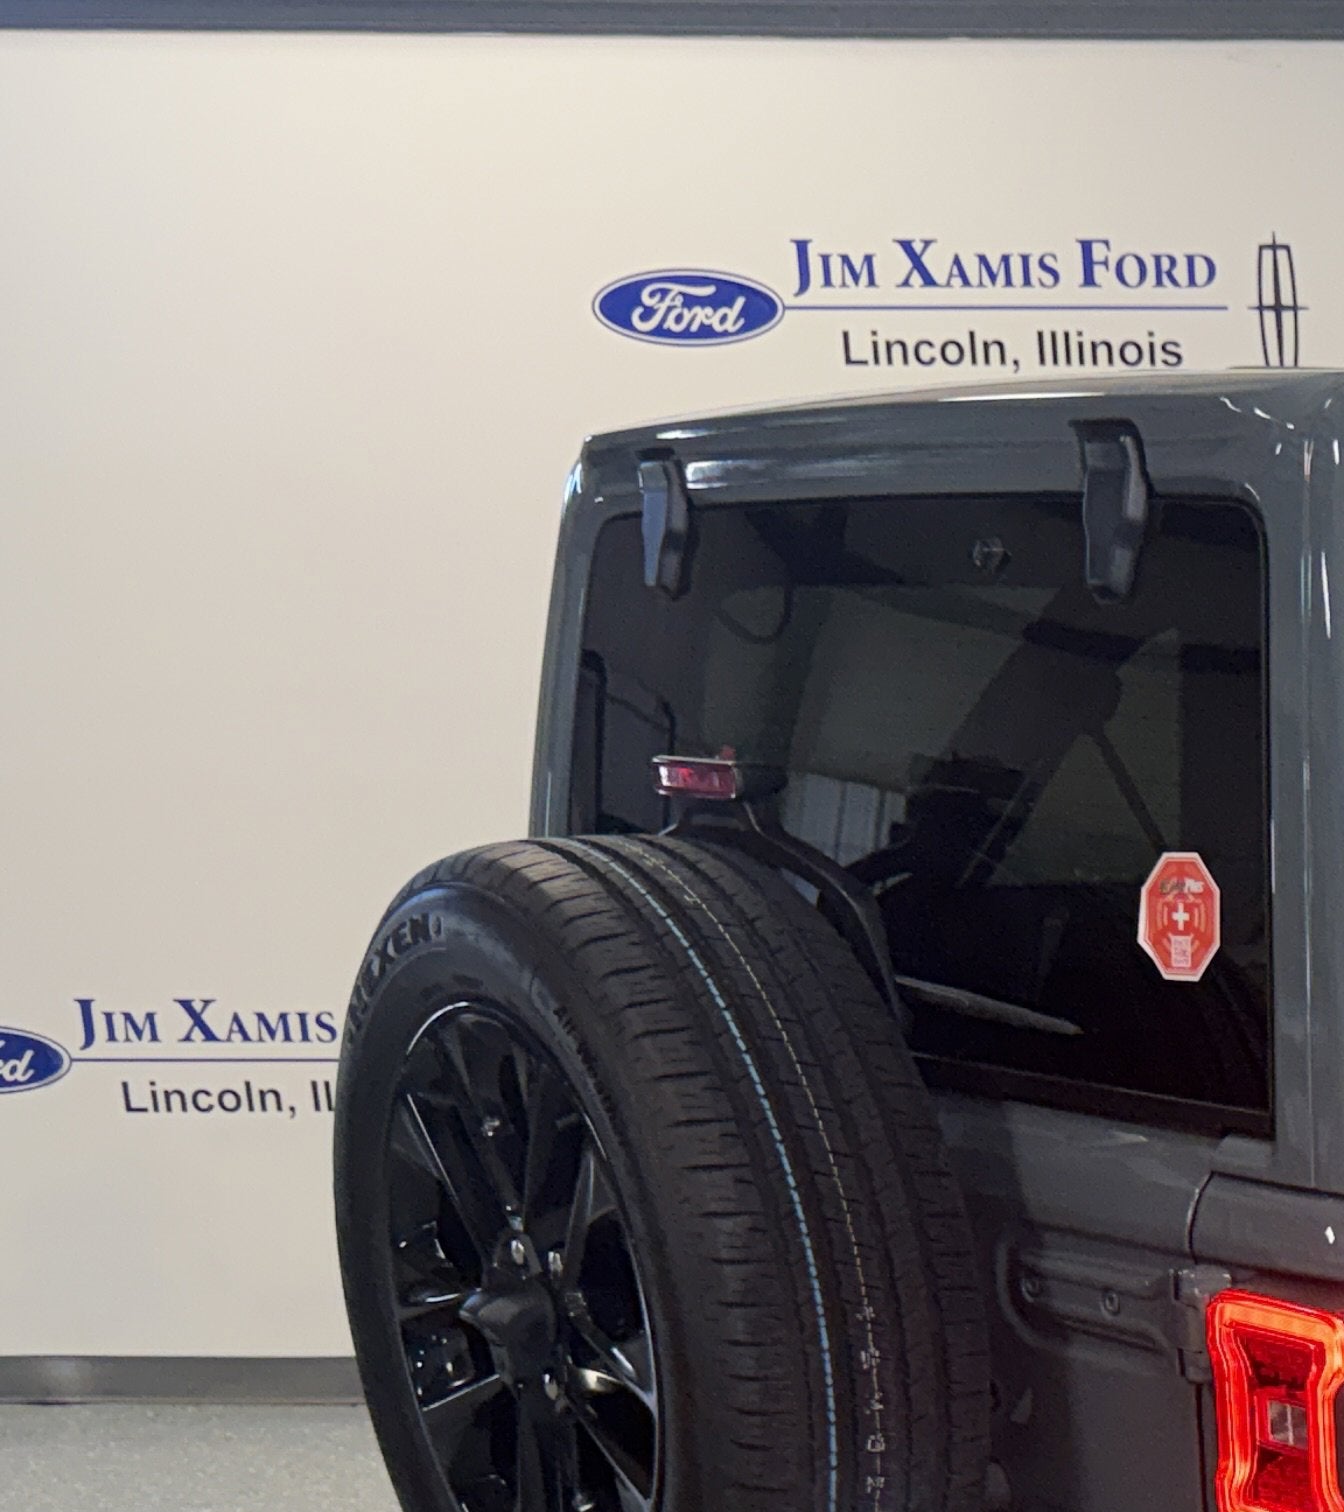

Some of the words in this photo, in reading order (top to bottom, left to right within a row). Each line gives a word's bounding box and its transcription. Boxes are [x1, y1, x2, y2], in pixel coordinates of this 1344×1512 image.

[790, 238, 878, 298] JIM
[893, 238, 1061, 289] XAMIS
[1076, 238, 1218, 289] FORD
[631, 282, 747, 333] Ford
[841, 329, 1021, 372] Lincoln,
[1036, 329, 1184, 368] Illinois
[348, 912, 431, 1033] NEXEN
[73, 997, 161, 1052] JIM
[172, 997, 338, 1044] XAMIS
[120, 1079, 297, 1119] Lincoln,
